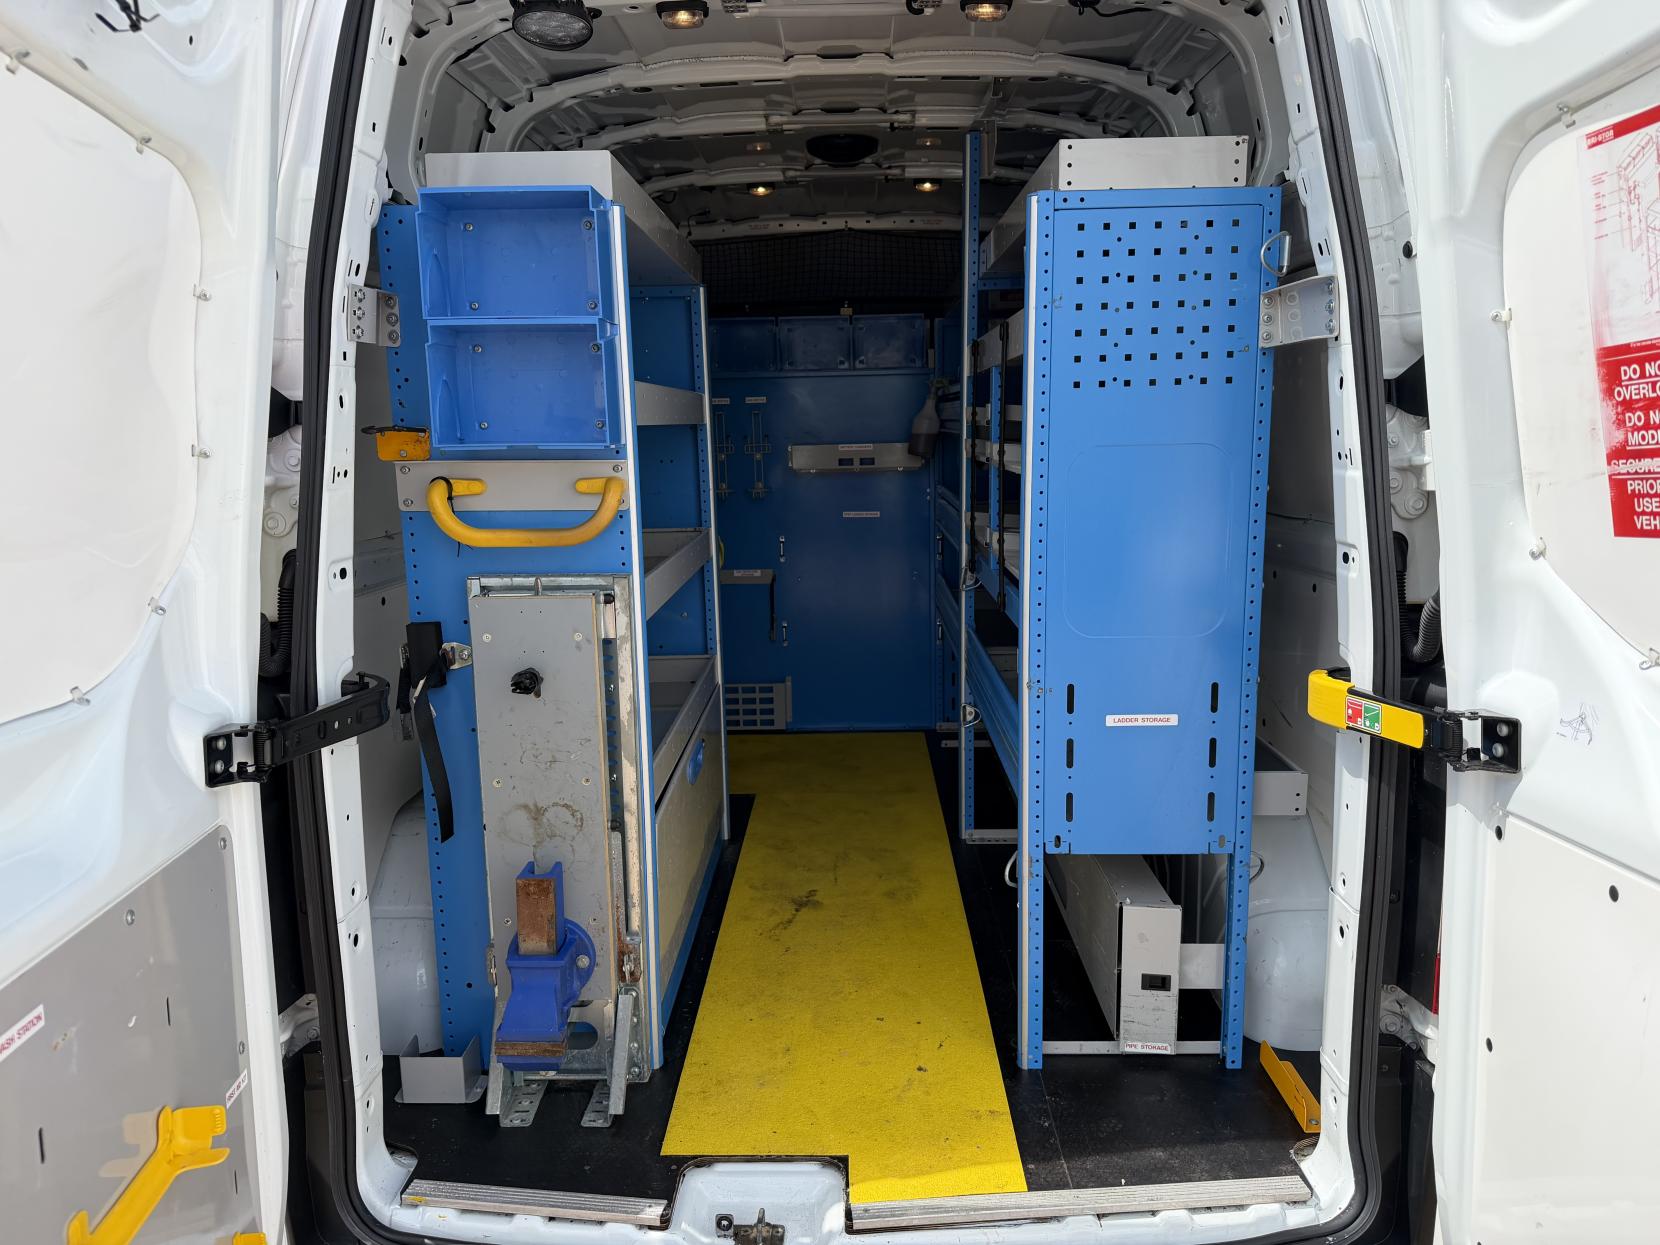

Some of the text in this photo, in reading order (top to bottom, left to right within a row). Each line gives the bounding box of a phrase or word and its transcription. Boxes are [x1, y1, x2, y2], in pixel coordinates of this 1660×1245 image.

[1621, 364, 1640, 380] DO
[1625, 411, 1644, 427] DO
[1634, 497, 1660, 512] USE
